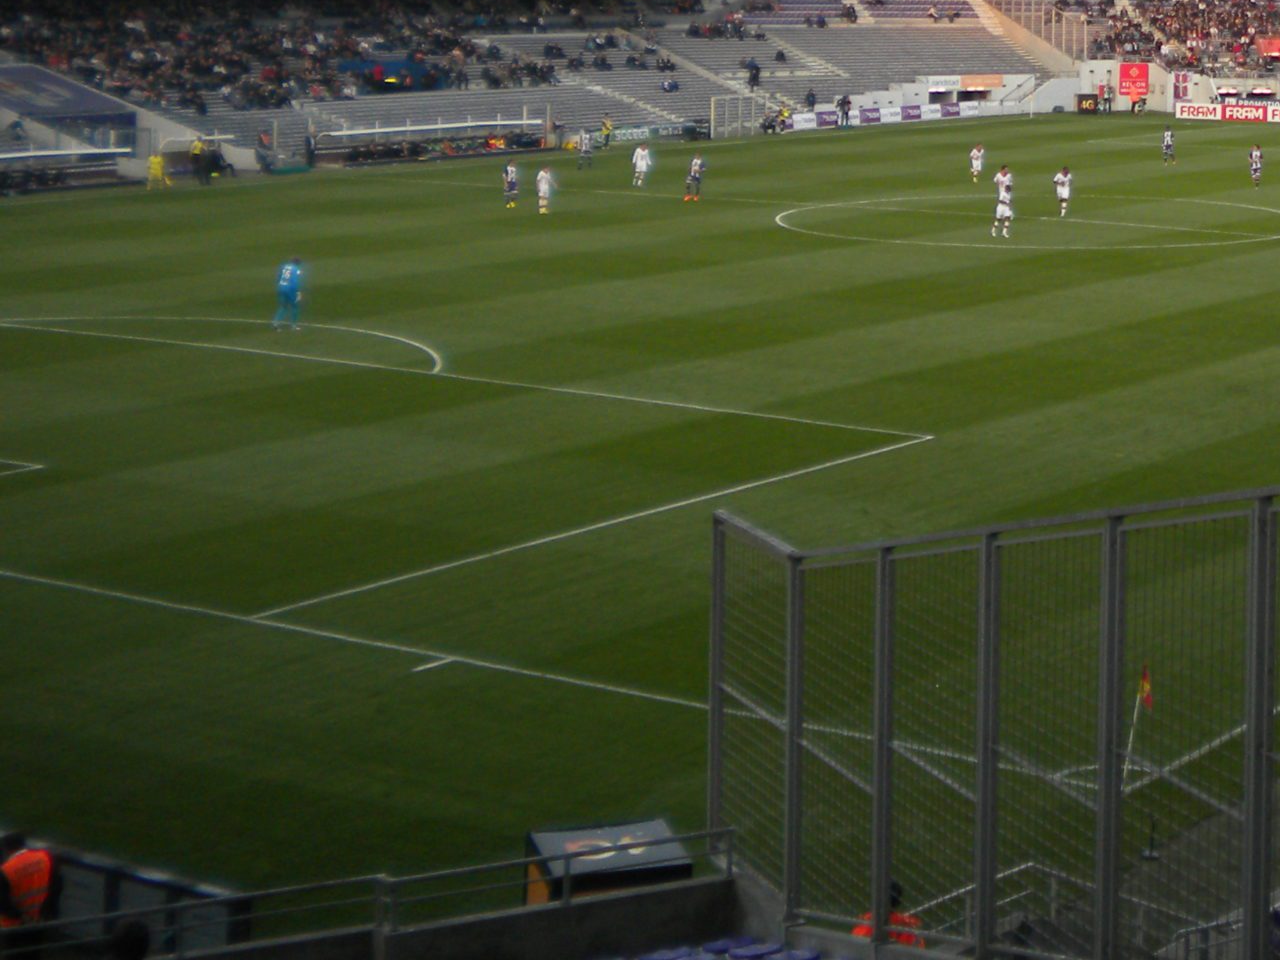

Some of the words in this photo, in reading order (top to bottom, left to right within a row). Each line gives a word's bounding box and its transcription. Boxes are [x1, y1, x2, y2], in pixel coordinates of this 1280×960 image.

[1080, 100, 1095, 110] 4G
[1180, 105, 1217, 117] FRAM
[1226, 107, 1264, 120] FRAM
